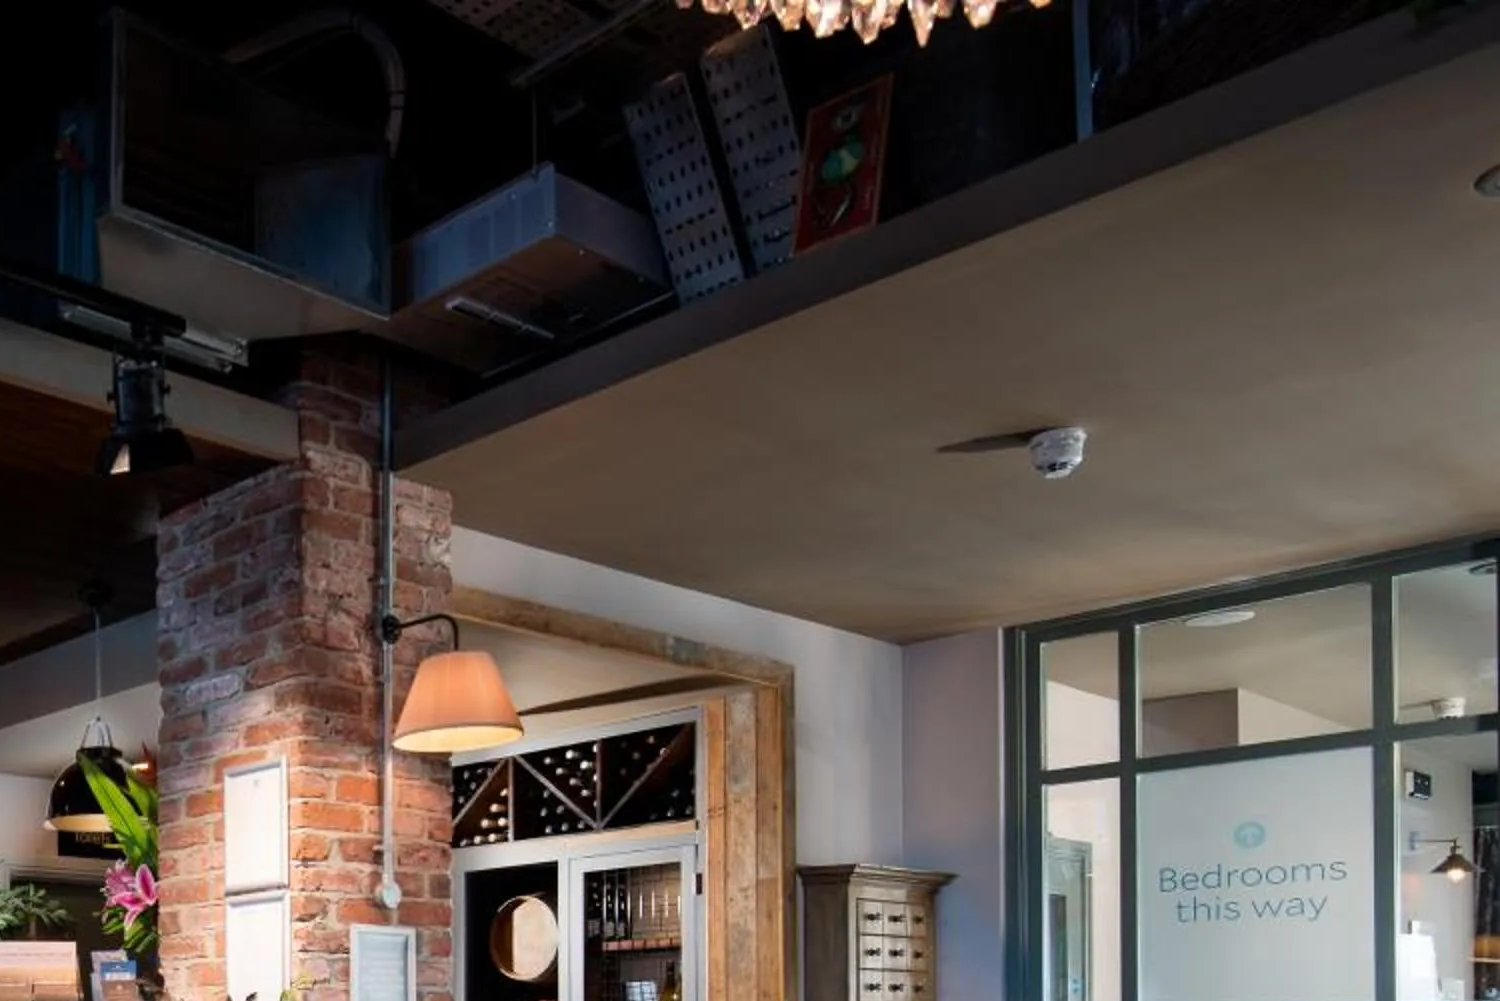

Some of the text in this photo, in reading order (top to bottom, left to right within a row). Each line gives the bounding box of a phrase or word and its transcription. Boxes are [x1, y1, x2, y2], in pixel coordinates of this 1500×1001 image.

[1158, 861, 1348, 893] Bedrooms
[1176, 895, 1328, 923] this way
